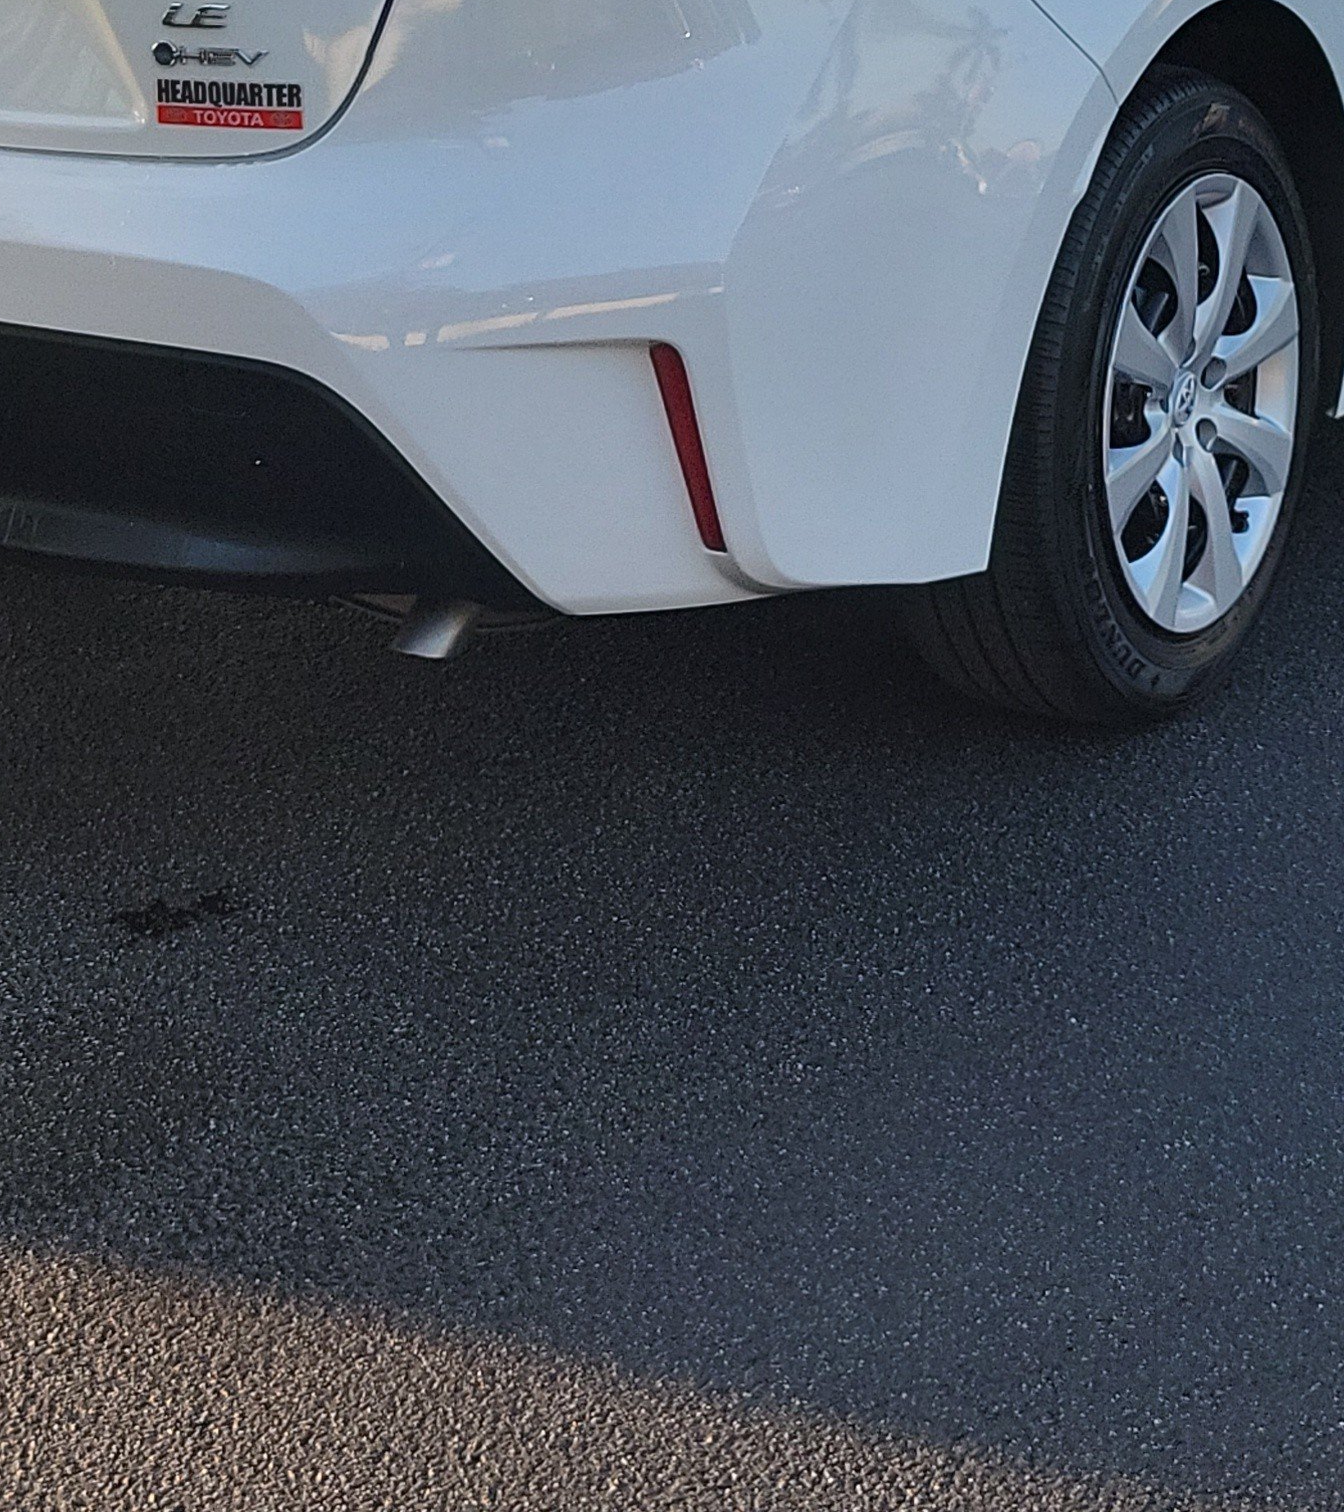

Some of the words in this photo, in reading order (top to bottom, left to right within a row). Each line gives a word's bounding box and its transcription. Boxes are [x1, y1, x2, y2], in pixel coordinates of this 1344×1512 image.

[162, 2, 231, 28] LE
[157, 78, 302, 108] HEADQUARTER
[193, 109, 264, 126] TOYOTA
